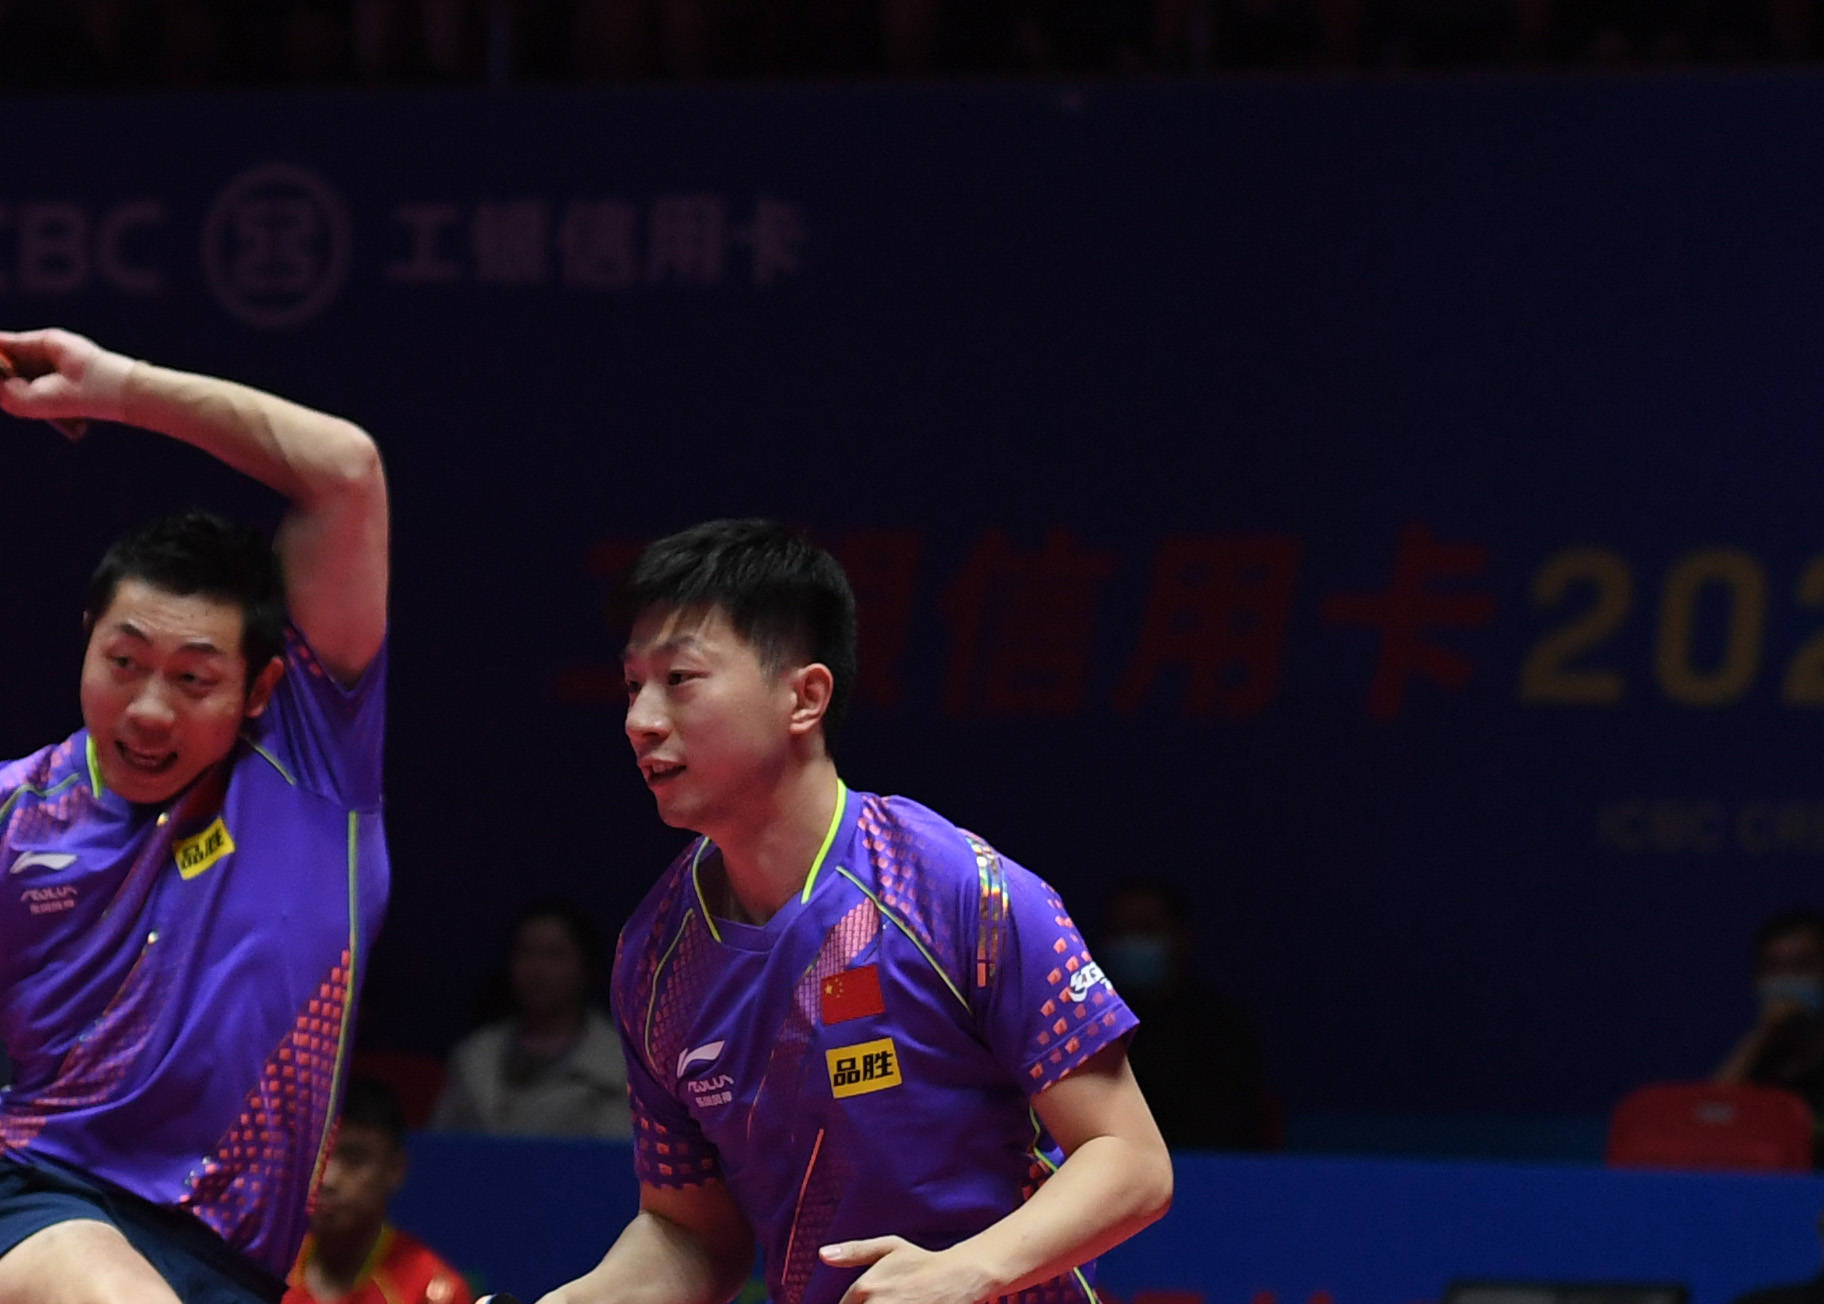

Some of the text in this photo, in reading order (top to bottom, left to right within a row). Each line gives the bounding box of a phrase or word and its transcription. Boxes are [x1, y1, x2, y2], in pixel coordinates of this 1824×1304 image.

[552, 520, 1498, 722] 信用卡
[833, 1050, 894, 1087] 品胜
